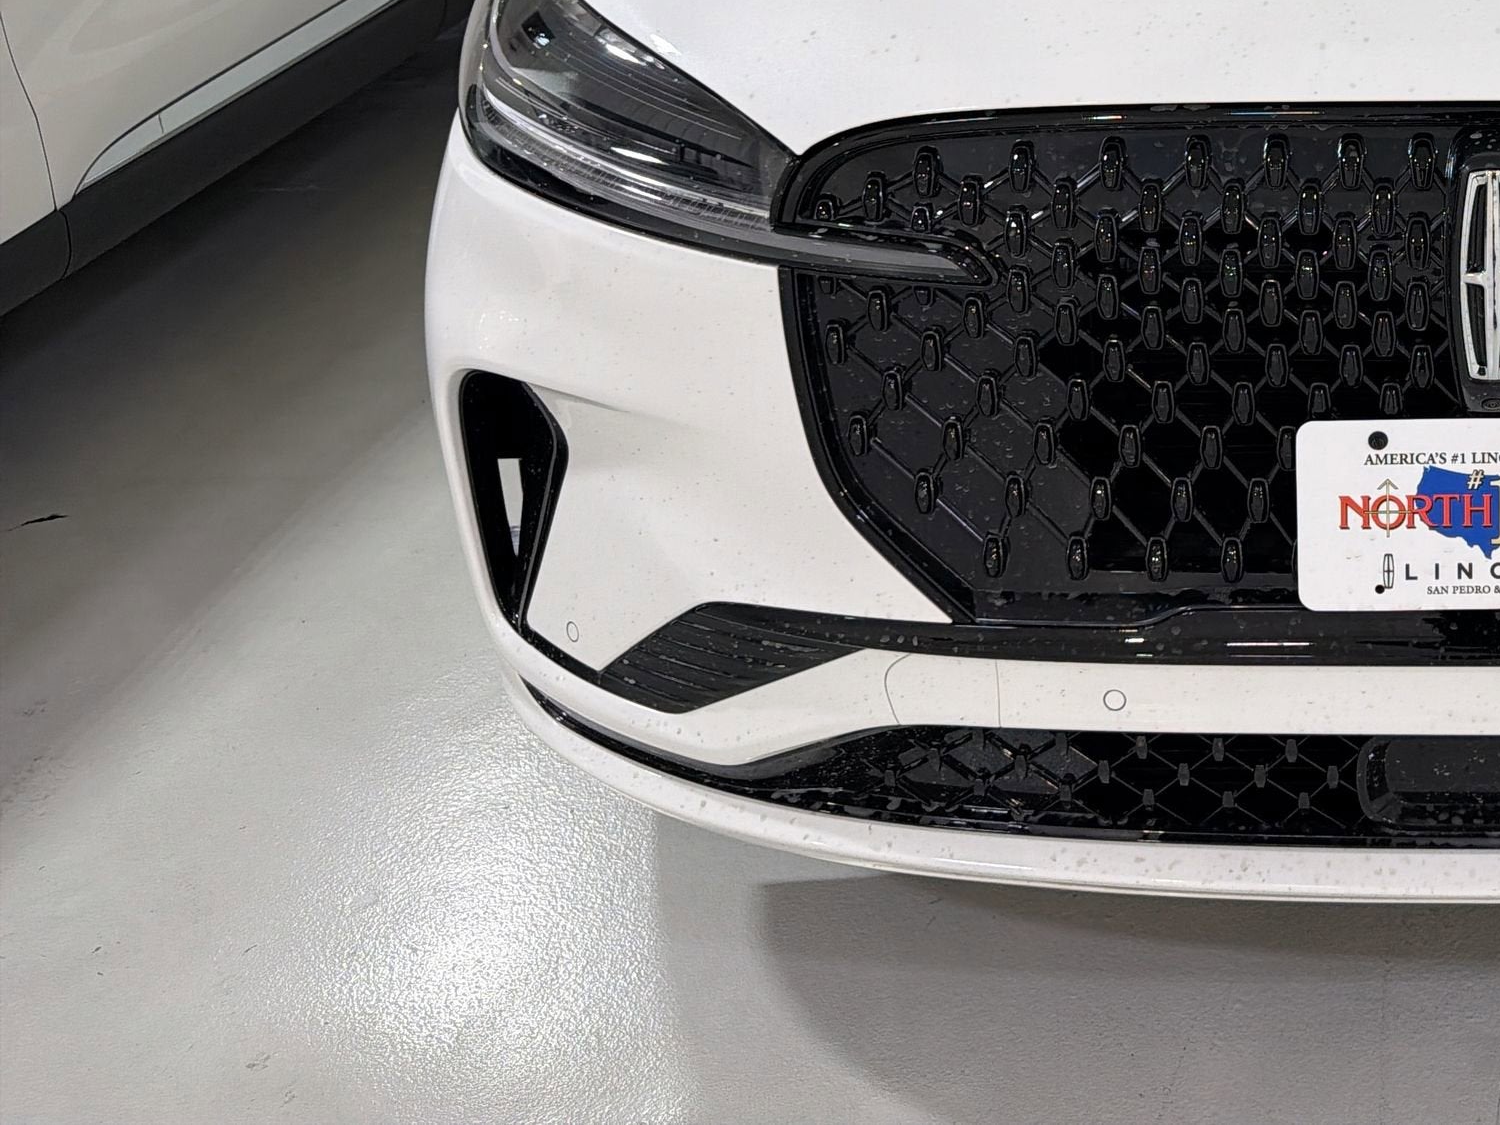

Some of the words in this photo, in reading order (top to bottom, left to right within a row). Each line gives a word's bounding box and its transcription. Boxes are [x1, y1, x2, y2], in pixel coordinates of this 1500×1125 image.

[1363, 452, 1448, 466] AMERICA'S
[1451, 452, 1466, 465] #1
[1338, 493, 1493, 530] NORTH
[1426, 585, 1450, 595] SAN
[1452, 585, 1491, 595] PEDRO
